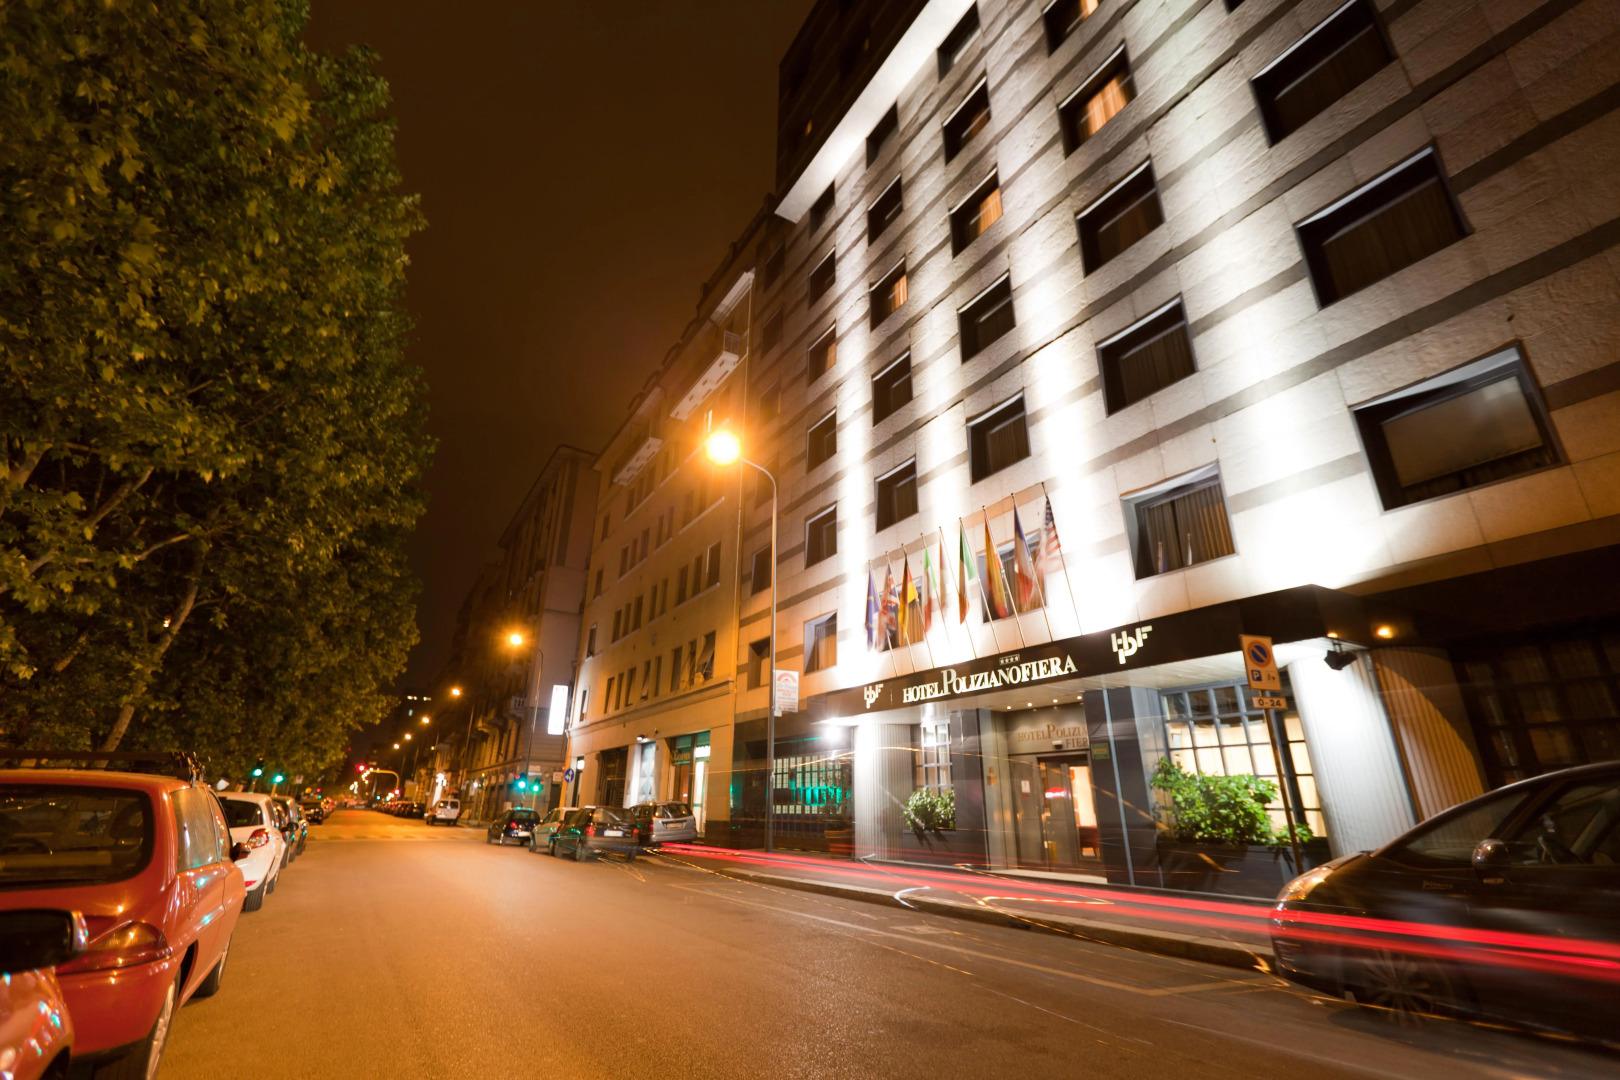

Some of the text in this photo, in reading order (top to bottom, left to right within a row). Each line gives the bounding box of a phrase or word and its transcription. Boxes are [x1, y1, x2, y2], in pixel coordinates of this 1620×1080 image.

[902, 681, 943, 703] HOTEL
[1020, 654, 1079, 683] FIERA
[1017, 730, 1048, 742] HOTEL
